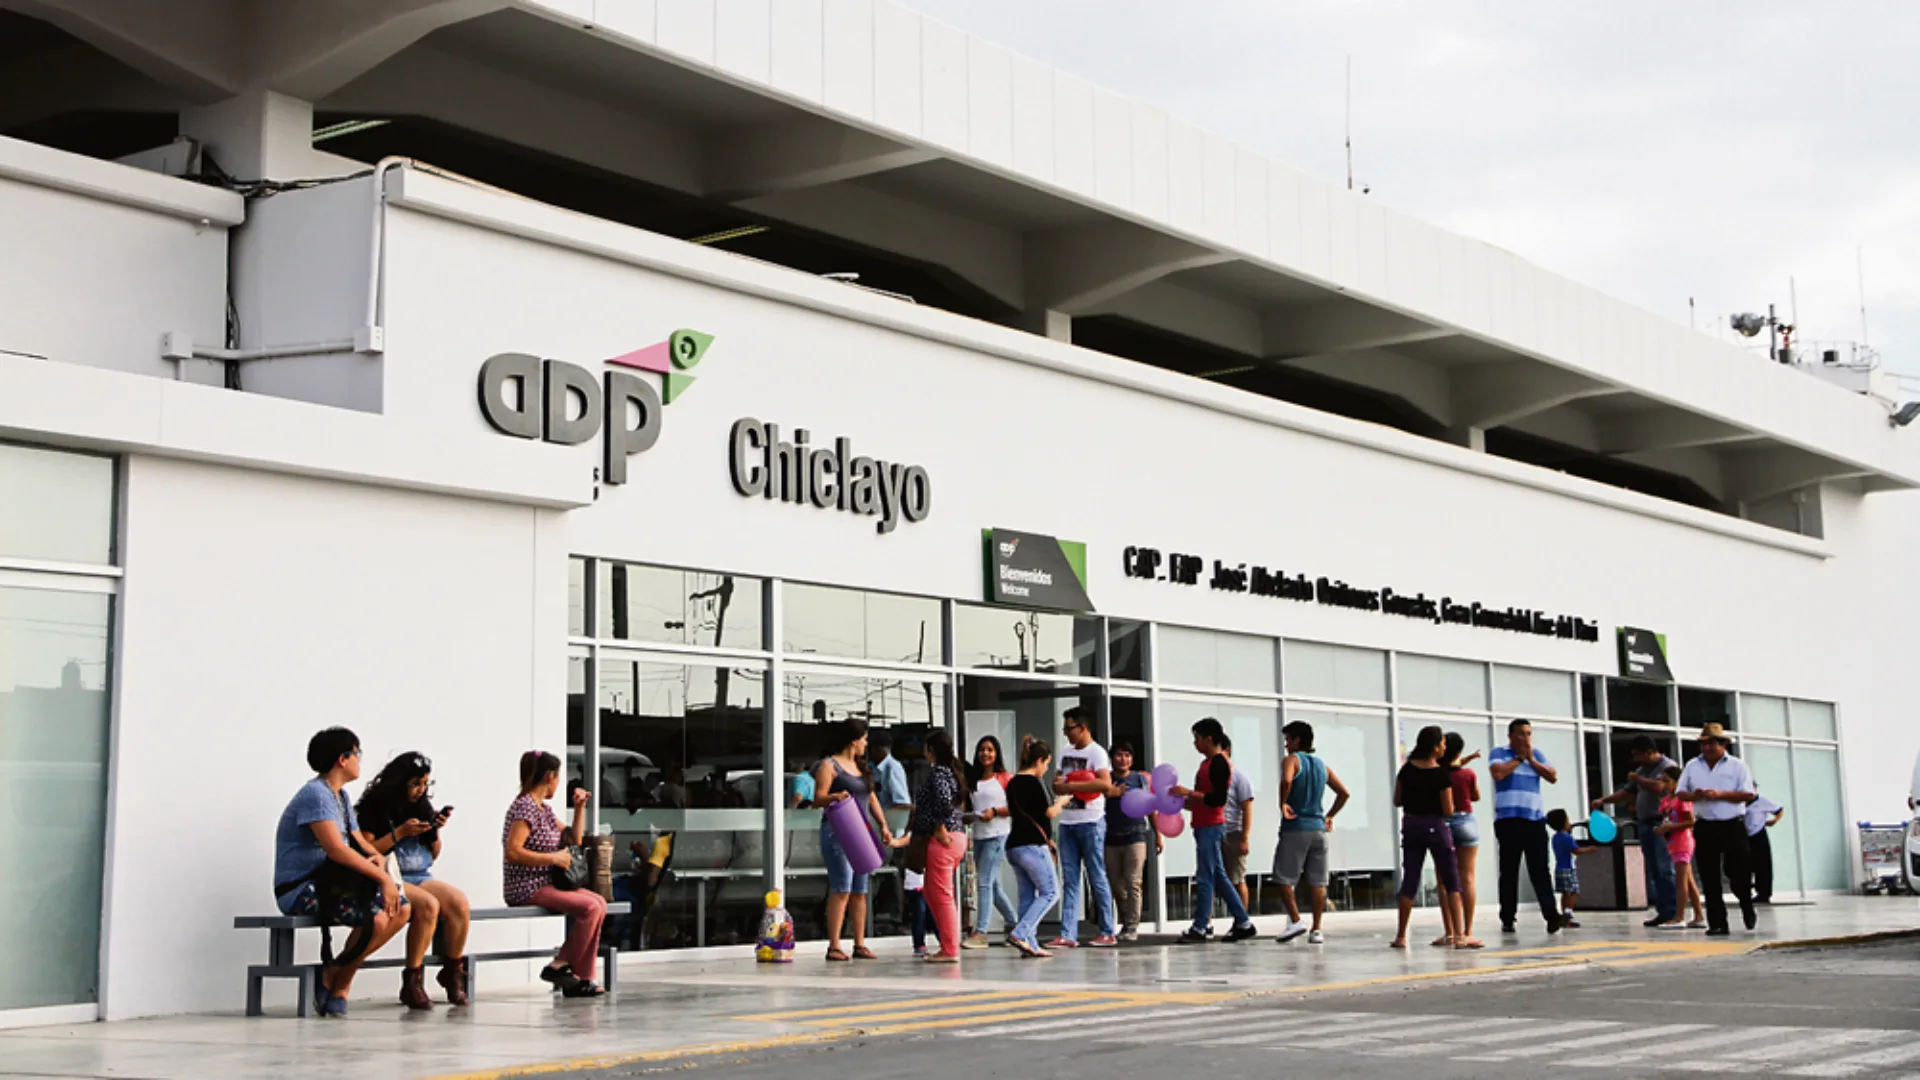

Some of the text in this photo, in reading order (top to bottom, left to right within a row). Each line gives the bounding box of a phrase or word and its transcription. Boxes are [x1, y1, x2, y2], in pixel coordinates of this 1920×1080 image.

[728, 416, 932, 534] Chiclayo
[1000, 564, 1052, 585] Bienvenidos
[1001, 582, 1029, 597] Welcome
